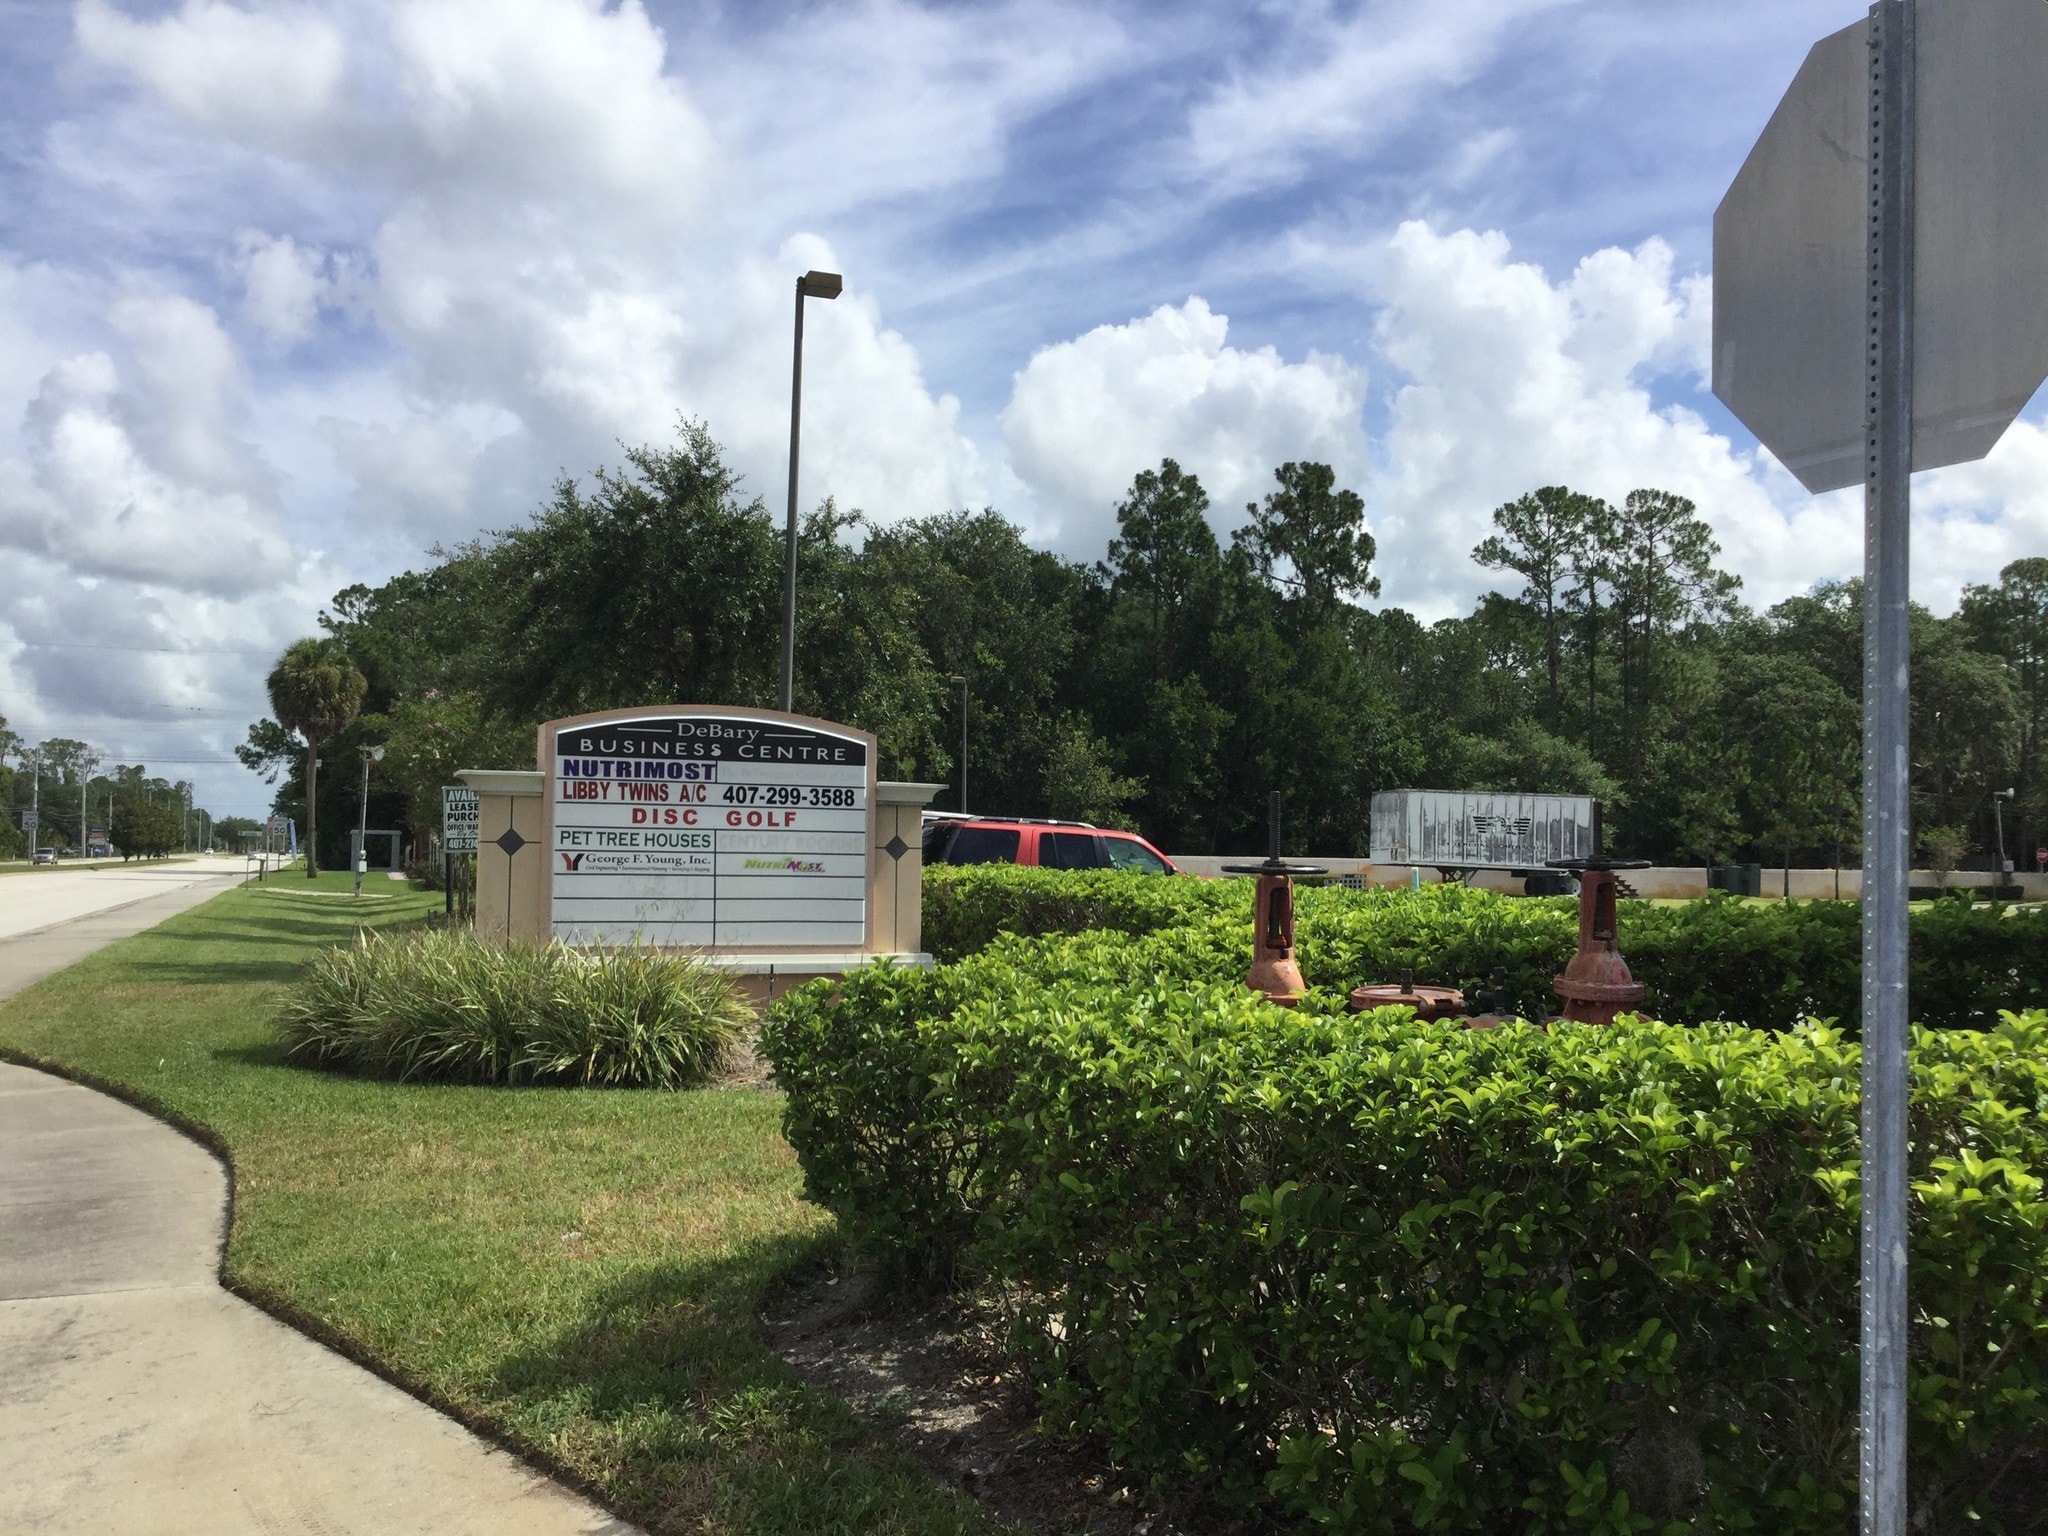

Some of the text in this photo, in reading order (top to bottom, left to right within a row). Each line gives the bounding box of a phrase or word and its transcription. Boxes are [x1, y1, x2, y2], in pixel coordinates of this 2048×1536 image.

[677, 722, 760, 743] DeBary
[580, 738, 846, 761] BUSINESS CENTRE
[563, 759, 716, 780] NUTRIMOST
[563, 781, 707, 803] LIBBY TWINS A/C
[722, 785, 856, 807] 407-299-3588
[631, 807, 797, 828] DISC GOLF
[560, 830, 712, 848] PET TREE HOUSES
[585, 853, 712, 866] George F. Young, Inc.
